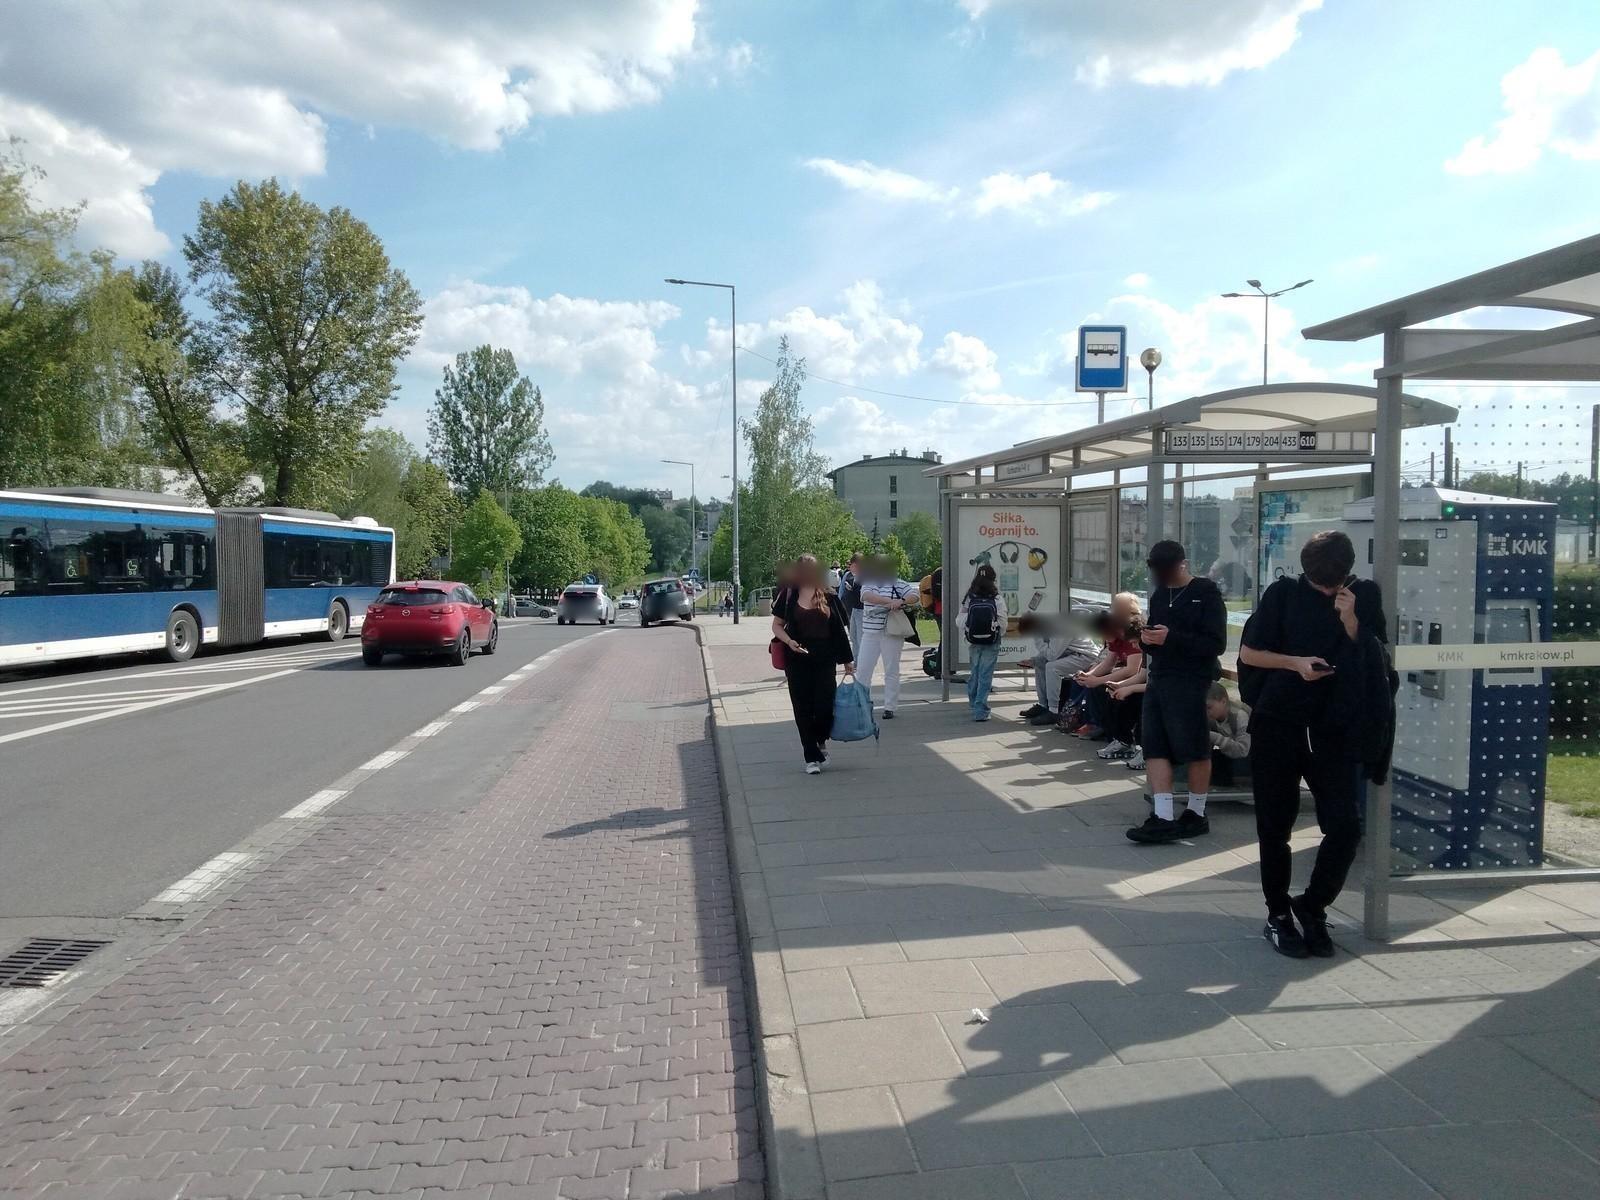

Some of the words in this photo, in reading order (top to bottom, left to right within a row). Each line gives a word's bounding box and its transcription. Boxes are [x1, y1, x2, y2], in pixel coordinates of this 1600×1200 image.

[1173, 436, 1187, 447] 133
[1191, 436, 1205, 447] 135
[1210, 436, 1224, 447] 155
[1228, 436, 1242, 447] 174
[1247, 436, 1261, 447] 179
[1264, 436, 1279, 447] 204
[1282, 436, 1297, 447] 433
[1300, 435, 1316, 447] 610
[993, 512, 1025, 523] Siłka.
[979, 525, 1022, 538] Ogarnij
[1024, 526, 1039, 536] to.
[1512, 539, 1548, 555] KMK
[1437, 651, 1464, 663] KMK
[1500, 649, 1574, 662] kmkrakow.pl
